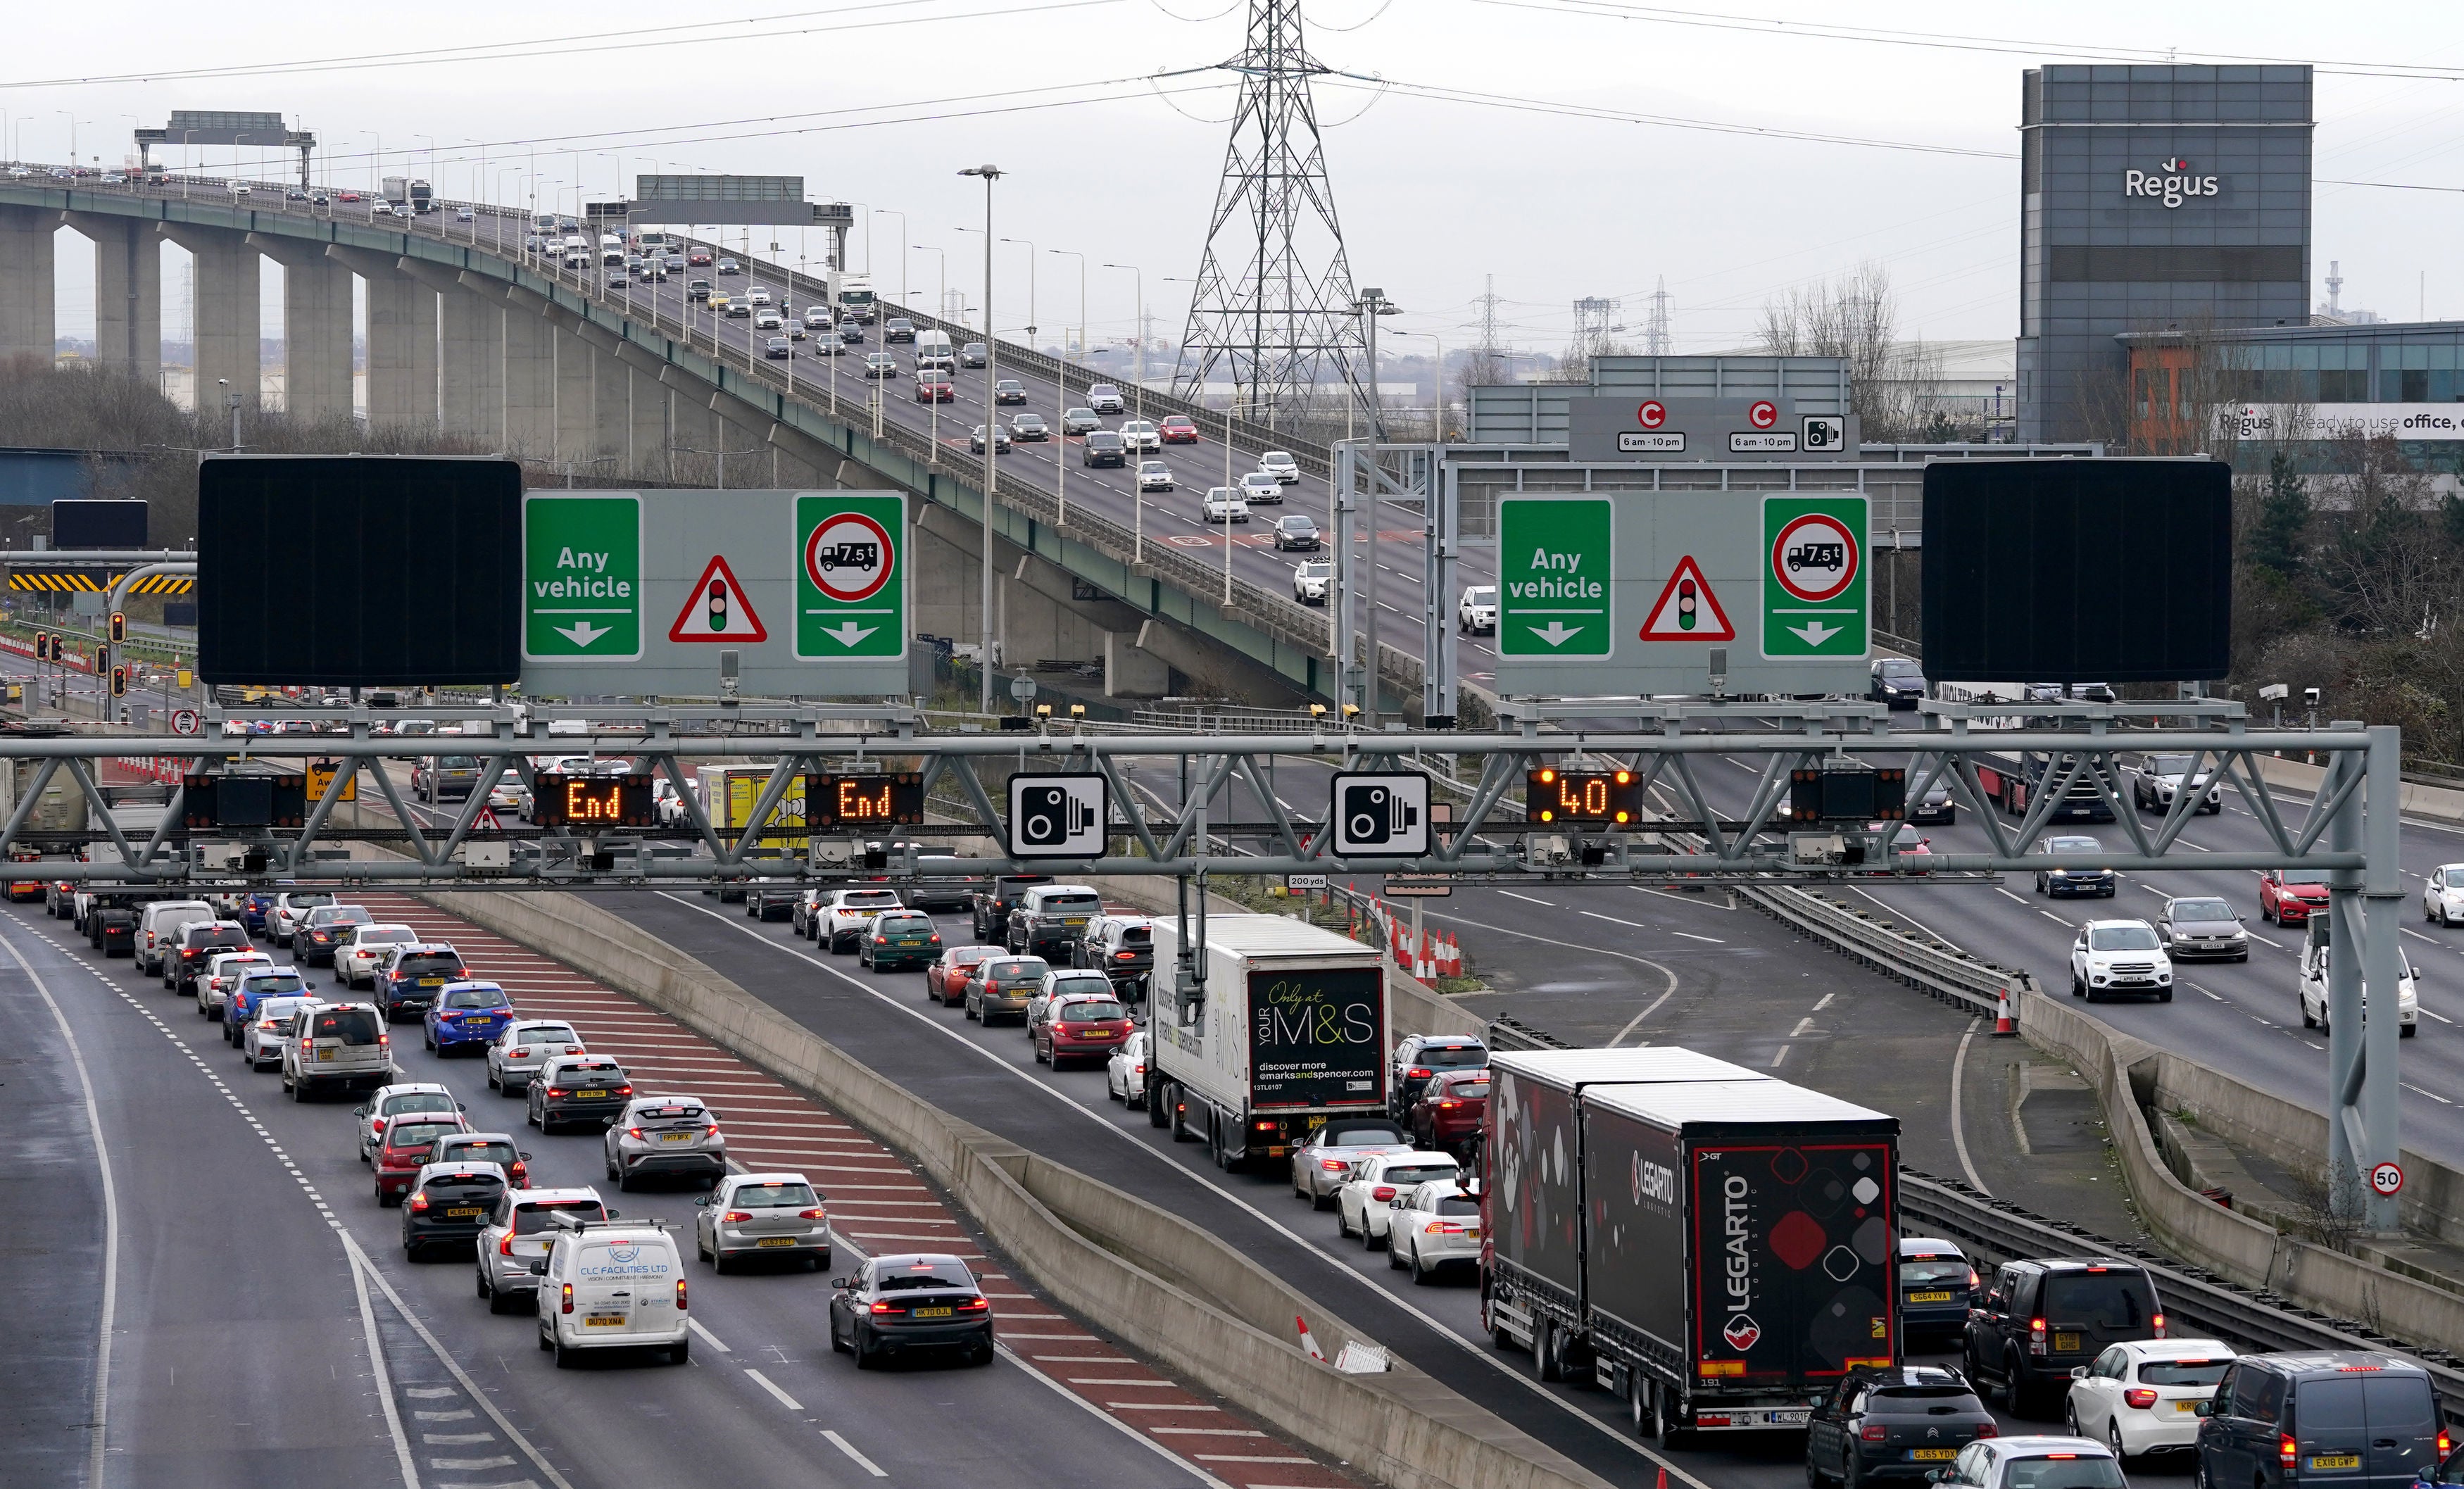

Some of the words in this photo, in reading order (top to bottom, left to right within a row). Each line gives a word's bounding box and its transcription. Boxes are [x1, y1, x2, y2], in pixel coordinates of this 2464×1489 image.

[2126, 169, 2218, 208] Regus
[1642, 403, 1661, 426] C
[1752, 403, 1773, 426] C
[2220, 413, 2273, 436] Regus
[2293, 414, 2345, 433] Ready
[2349, 417, 2365, 429] to
[2370, 417, 2399, 429] use
[2403, 414, 2457, 431] office,
[1623, 437, 1630, 446] 6
[1652, 437, 1664, 446] 10
[1666, 439, 1680, 448] pm
[1735, 437, 1742, 446] 6
[1764, 437, 1775, 446] 10
[1777, 439, 1791, 448] pm
[556, 546, 609, 573] Any
[1530, 548, 1581, 574] Any
[534, 576, 631, 598] vehicle
[1509, 577, 1602, 599] vehicle
[568, 782, 620, 819] End
[839, 782, 891, 817] End
[1561, 779, 1606, 814] 40
[1310, 877, 1324, 886] yds
[1269, 981, 1304, 1015] Only
[1305, 989, 1324, 1003] at
[1258, 1007, 1271, 1046] YOUR
[1274, 1003, 1374, 1045] M&S
[1259, 1062, 1300, 1072] discover
[1259, 1069, 1374, 1081] @marksandspencer.com
[1709, 1152, 1722, 1161] GT
[1640, 1159, 1673, 1205] LEGARTO
[2377, 1172, 2399, 1186] 50
[1643, 1200, 1671, 1219] LOGISTIC
[1724, 1176, 1750, 1312] LEGARTO
[1751, 1188, 1759, 1299] LOGISTIC
[601, 1265, 648, 1274] FACILITIES
[1701, 1378, 1721, 1387] 191
[1777, 1413, 1787, 1421] WL
[1938, 1450, 1956, 1458] YDX
